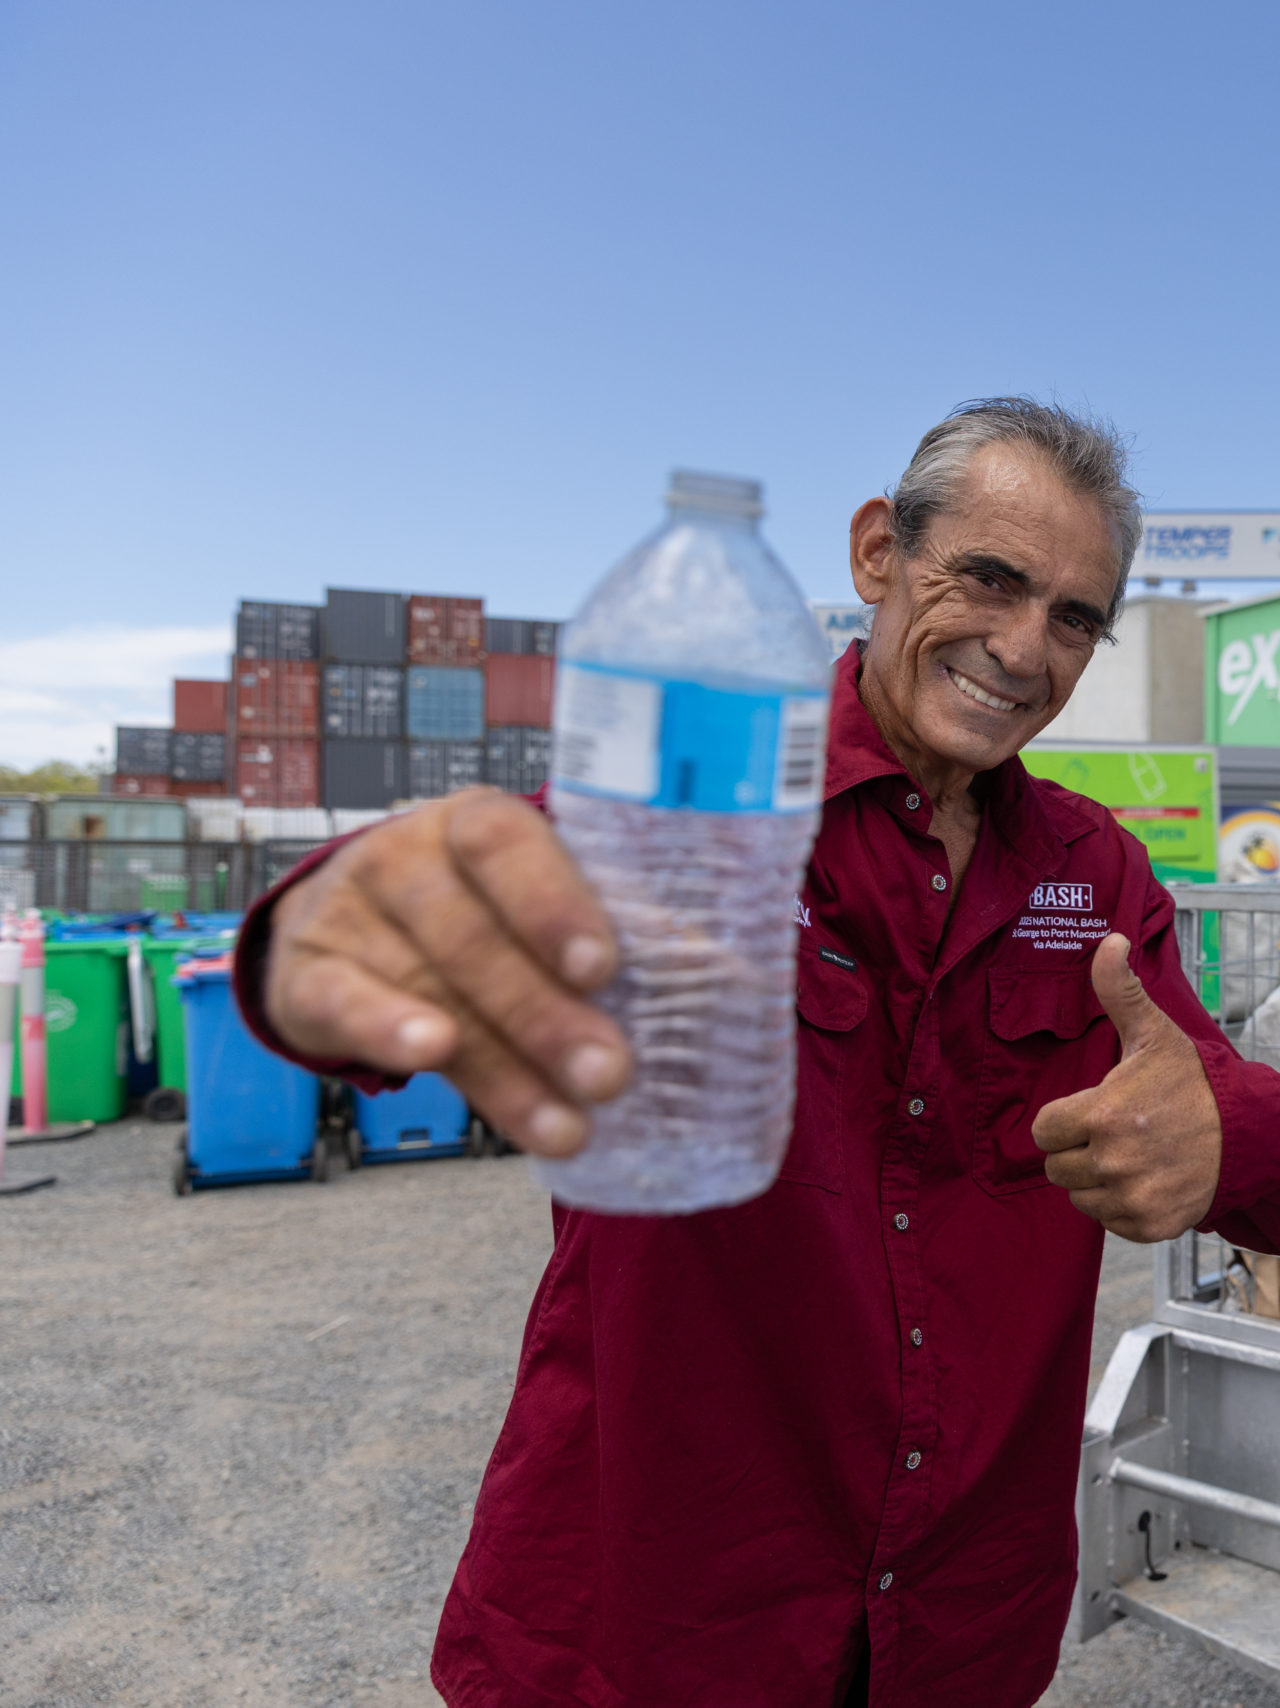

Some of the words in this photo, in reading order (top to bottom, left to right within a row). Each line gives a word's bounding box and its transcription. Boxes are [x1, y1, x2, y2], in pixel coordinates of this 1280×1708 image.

[1033, 886, 1083, 907] BASH
[1033, 917, 1079, 927] NATIONAL
[1080, 918, 1107, 928] BASH
[1017, 928, 1039, 939] George
[1040, 929, 1049, 938] to
[1050, 928, 1069, 938] Port
[1033, 940, 1044, 949] via
[1045, 940, 1082, 950] Adelaide
